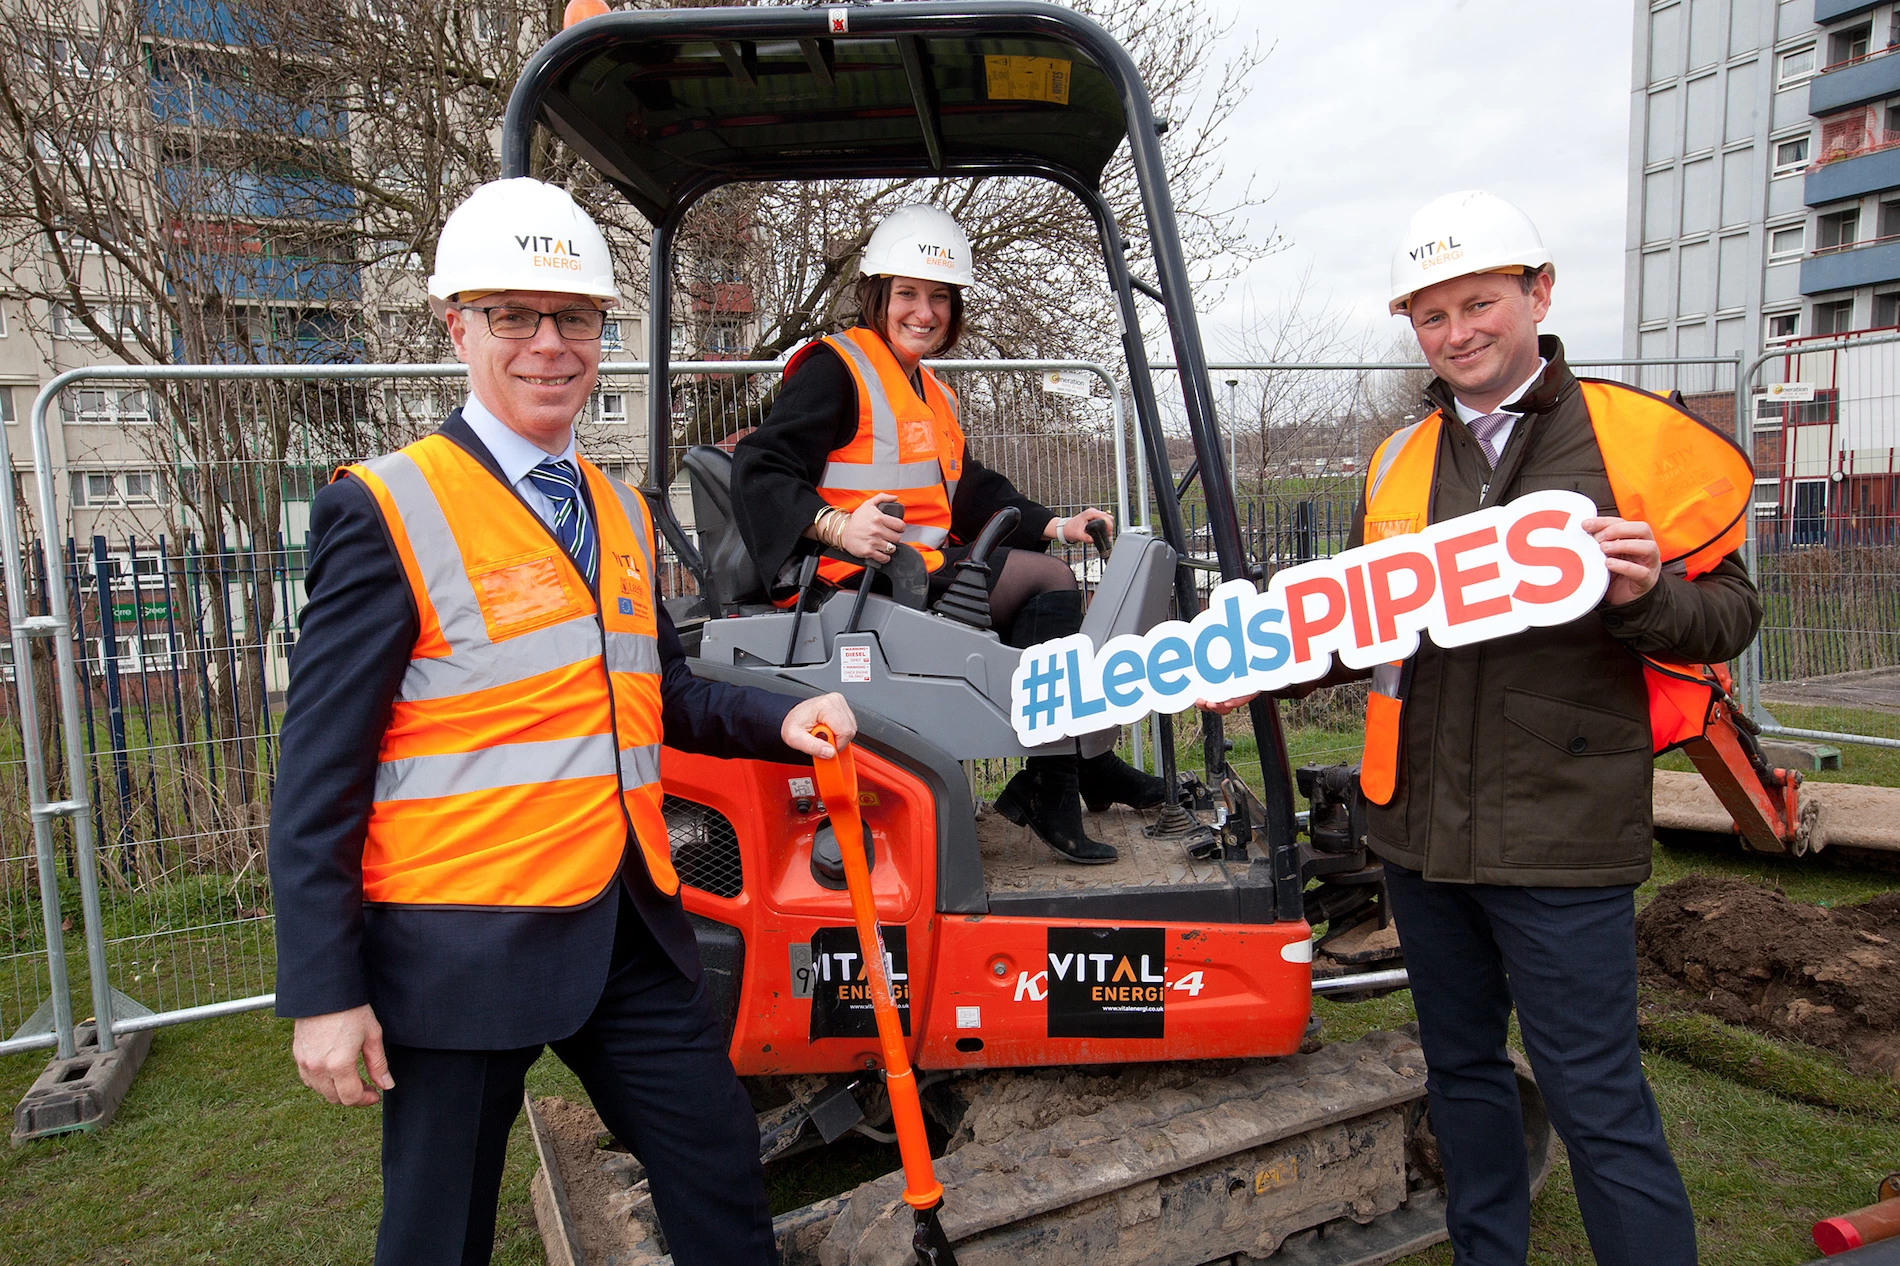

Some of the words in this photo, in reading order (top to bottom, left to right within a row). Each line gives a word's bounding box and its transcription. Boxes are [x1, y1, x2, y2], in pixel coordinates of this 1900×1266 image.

[514, 235, 580, 257] VITAL
[918, 244, 955, 260] VITAL
[1409, 236, 1462, 261] VITAL
[111, 607, 132, 617] orre
[1022, 509, 1586, 731] #LeedsPIPES
[1048, 953, 1164, 983] VITAL
[796, 967, 814, 993] 9
[838, 984, 909, 1000] ENEGi
